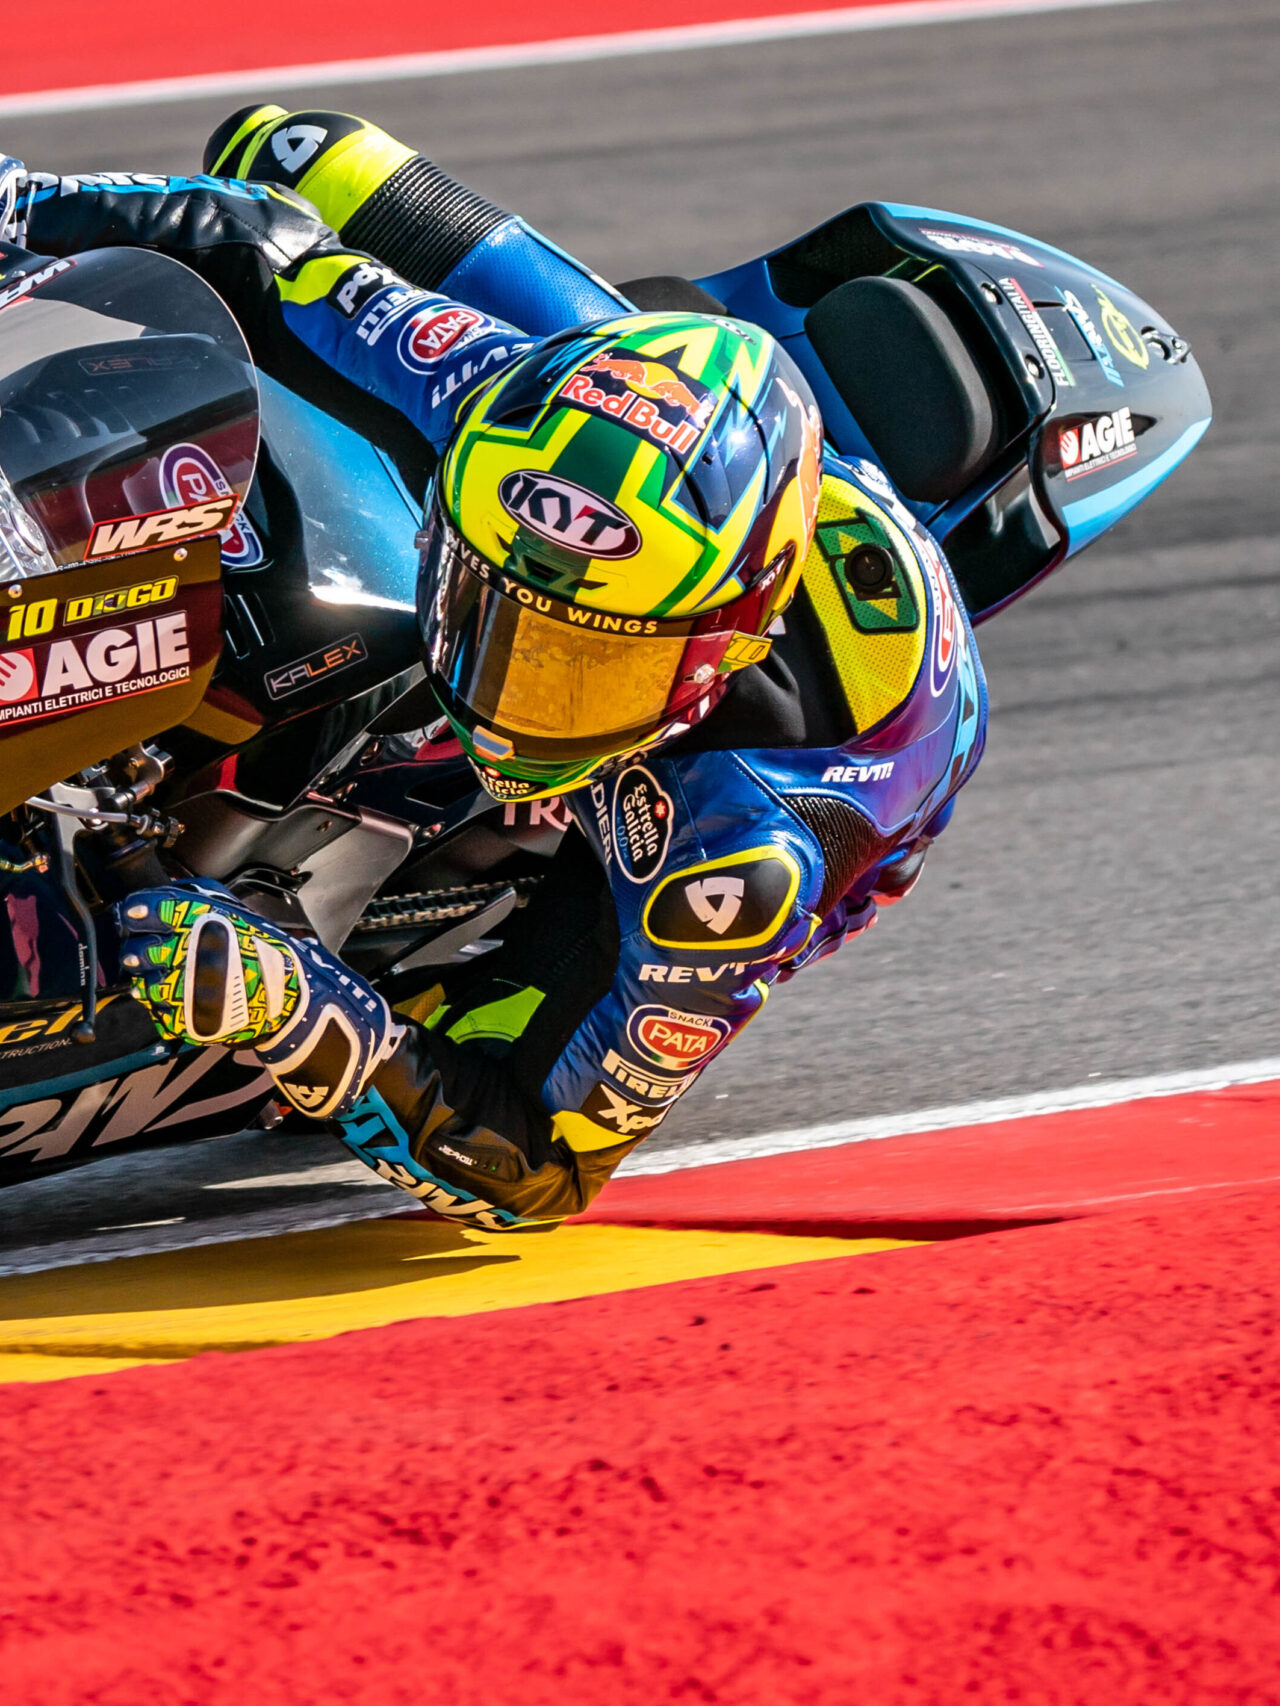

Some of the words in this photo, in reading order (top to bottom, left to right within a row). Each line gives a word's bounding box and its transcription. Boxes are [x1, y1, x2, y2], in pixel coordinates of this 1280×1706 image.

[417, 311, 472, 354] PATA
[1081, 406, 1135, 462] AGIE
[91, 499, 234, 555] WRS
[508, 474, 623, 547] KYT
[7, 598, 58, 642] 10
[502, 578, 552, 612] YOU
[567, 607, 658, 635] WINGS
[41, 612, 191, 698] AGIE
[270, 640, 362, 693] KALEX
[44, 689, 103, 711] ELETTRICI
[105, 685, 114, 697] E
[115, 666, 190, 694] TECNOLOGICI
[590, 782, 614, 866] DIERI
[622, 794, 644, 863] Galicia
[633, 782, 660, 857] Estrella
[648, 1023, 708, 1053] PATA
[669, 1011, 712, 1027] SNACK
